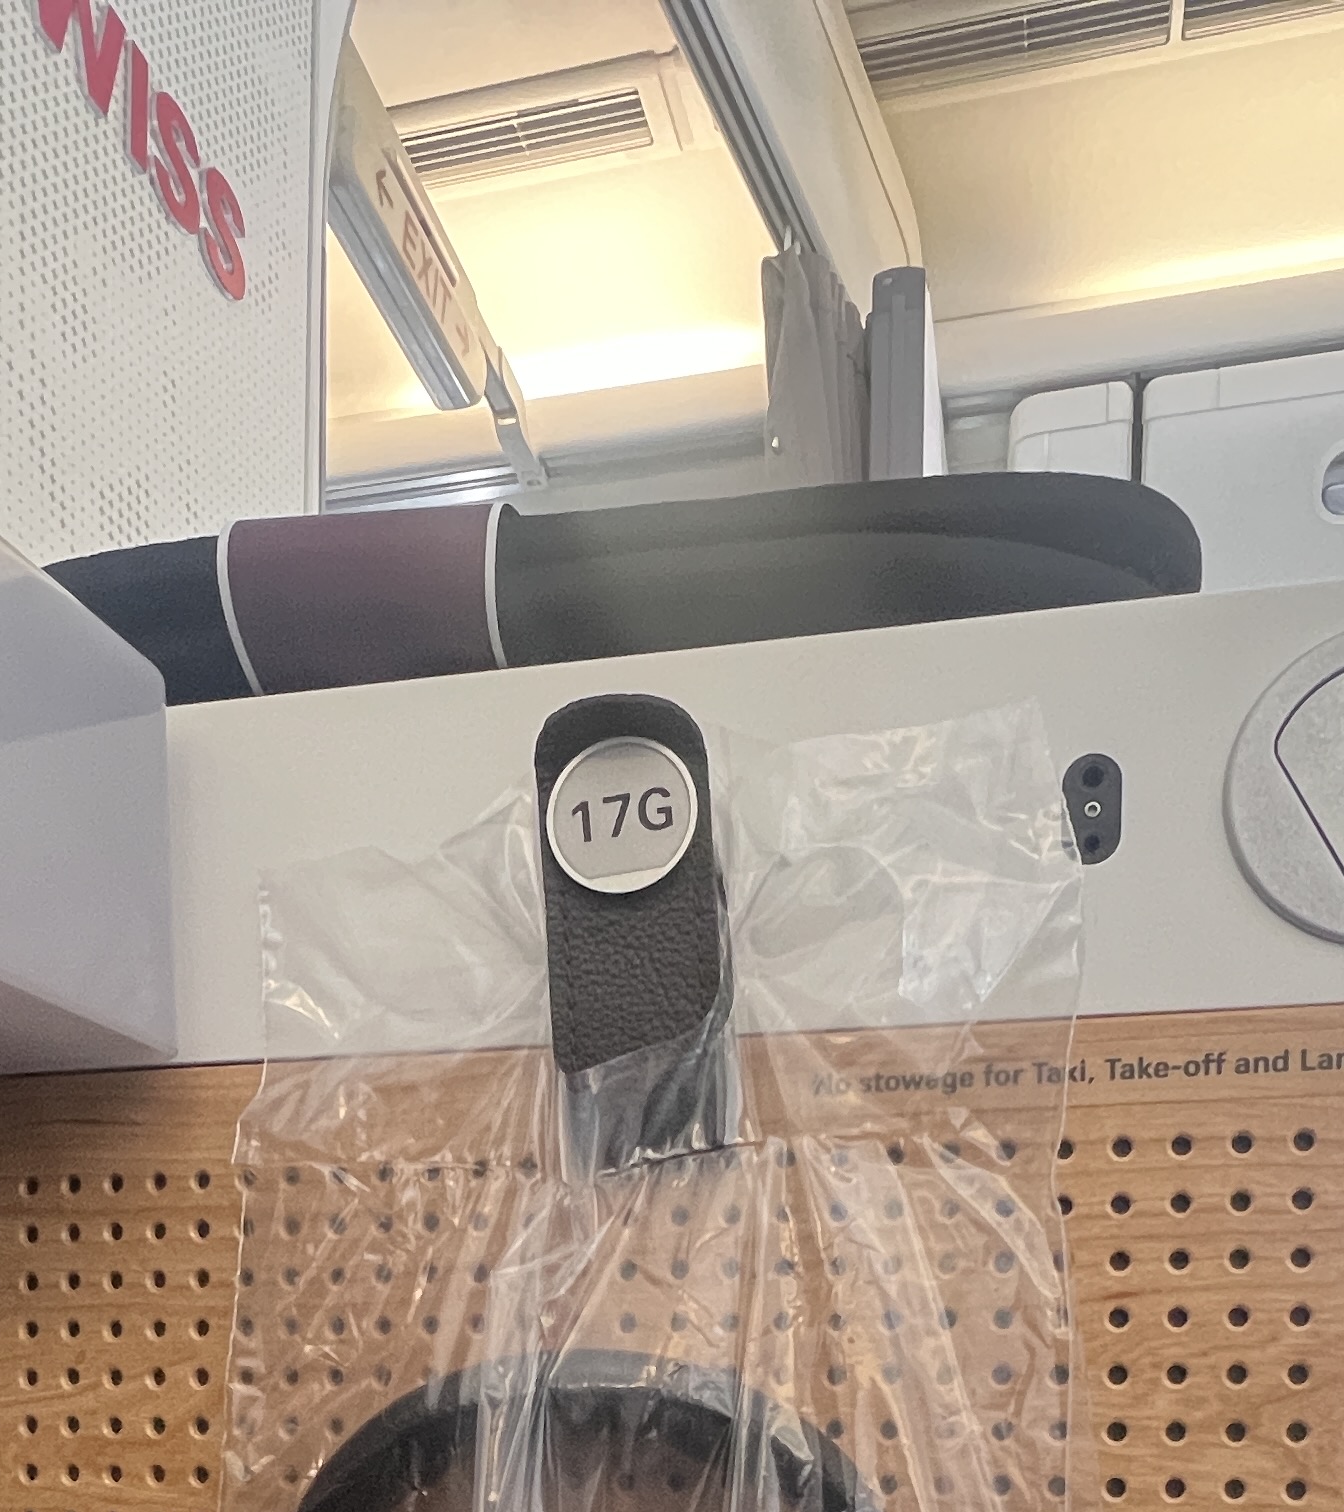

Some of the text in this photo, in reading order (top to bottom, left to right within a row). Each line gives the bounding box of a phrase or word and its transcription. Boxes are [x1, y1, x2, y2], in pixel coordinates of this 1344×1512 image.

[402, 209, 452, 324] EXIT
[571, 786, 674, 843] 17G
[983, 1062, 1024, 1088] for
[1032, 1057, 1096, 1086] Taxi,
[1105, 1050, 1227, 1082] Take-off
[1233, 1047, 1290, 1076] and
